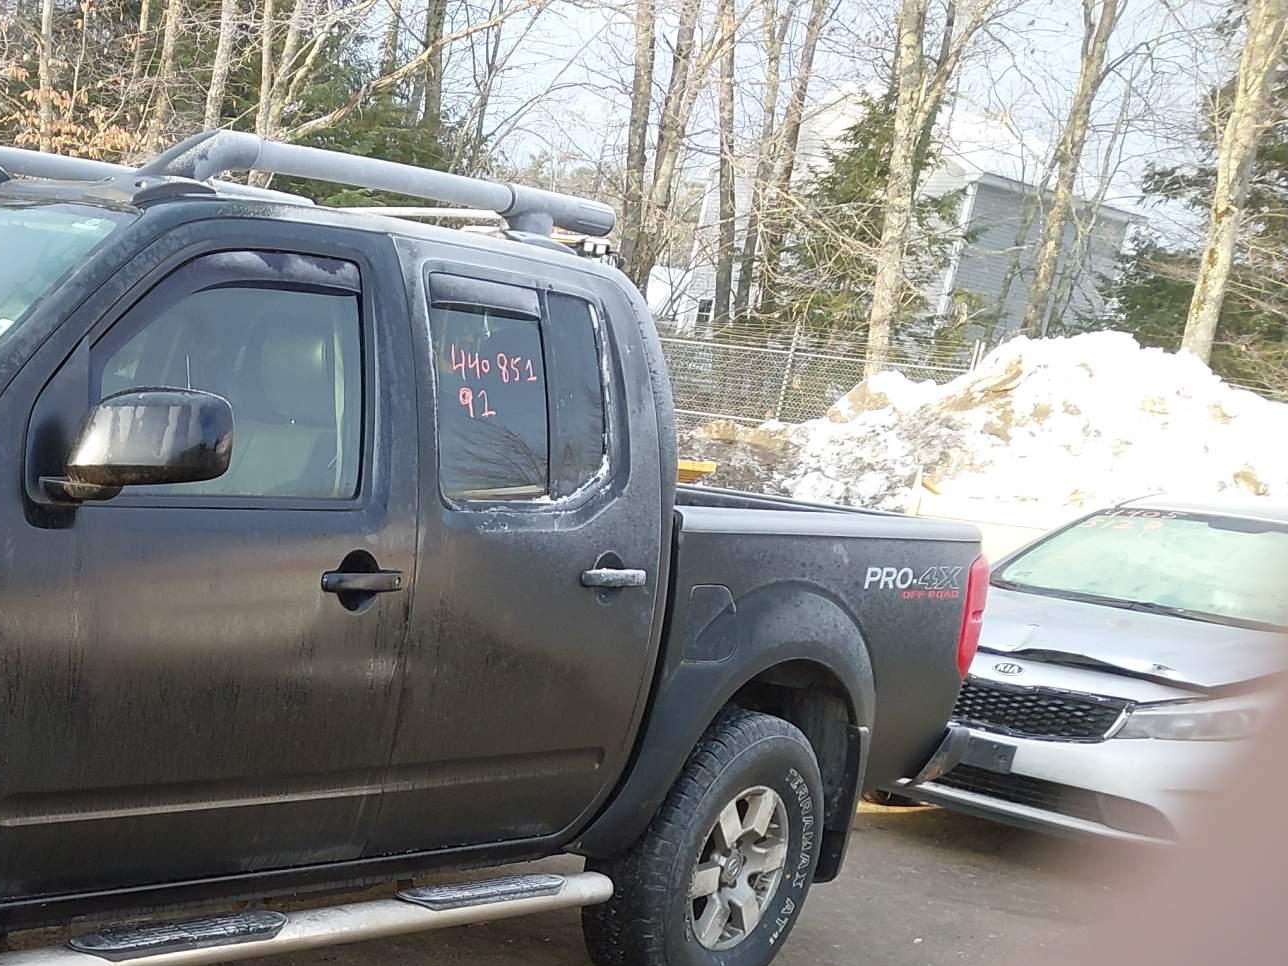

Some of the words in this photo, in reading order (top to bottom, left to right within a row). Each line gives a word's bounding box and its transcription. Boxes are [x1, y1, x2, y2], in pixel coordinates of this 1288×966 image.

[902, 590, 926, 600] OFF
[927, 590, 960, 599] ROAD
[994, 662, 1021, 674] KIA
